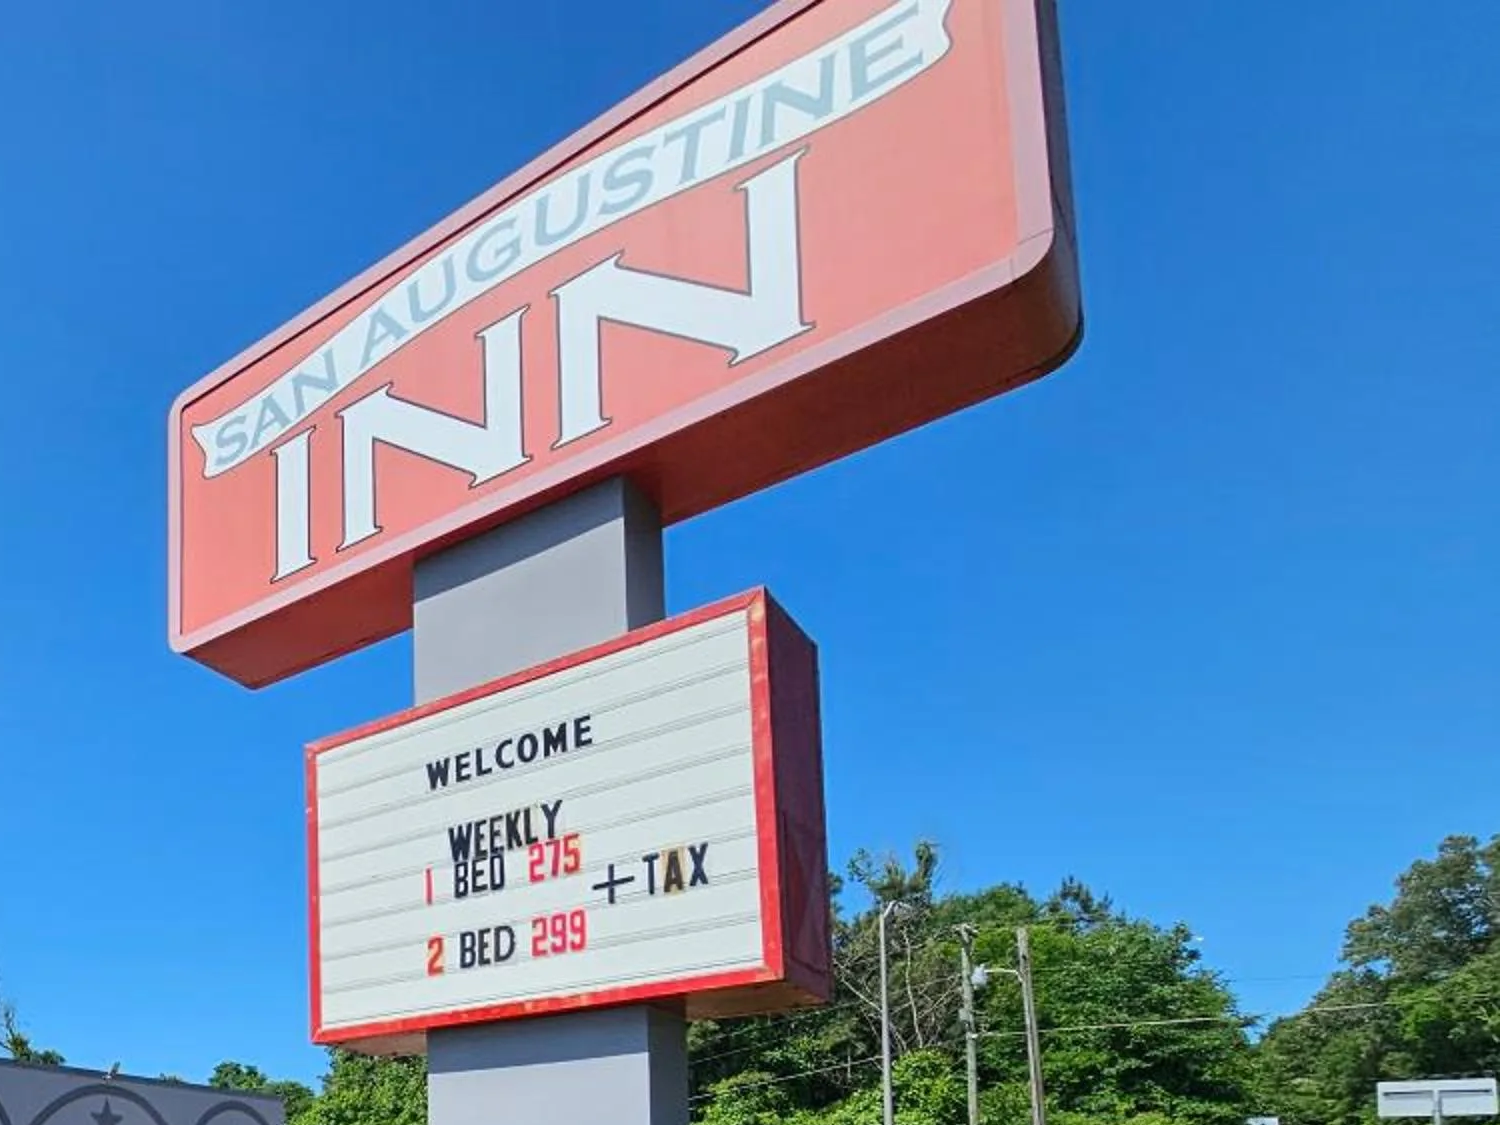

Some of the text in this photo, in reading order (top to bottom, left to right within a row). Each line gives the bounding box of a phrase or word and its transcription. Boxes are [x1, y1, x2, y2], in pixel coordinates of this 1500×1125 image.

[212, 10, 925, 468] SAN AUGUSTINE
[270, 147, 816, 583] INN
[425, 714, 594, 791] WELCOME
[448, 799, 563, 863] WEEKLY
[424, 867, 434, 906] 1
[453, 852, 506, 899] BED
[527, 833, 581, 883] 275
[426, 909, 587, 977] 2 BED 299
